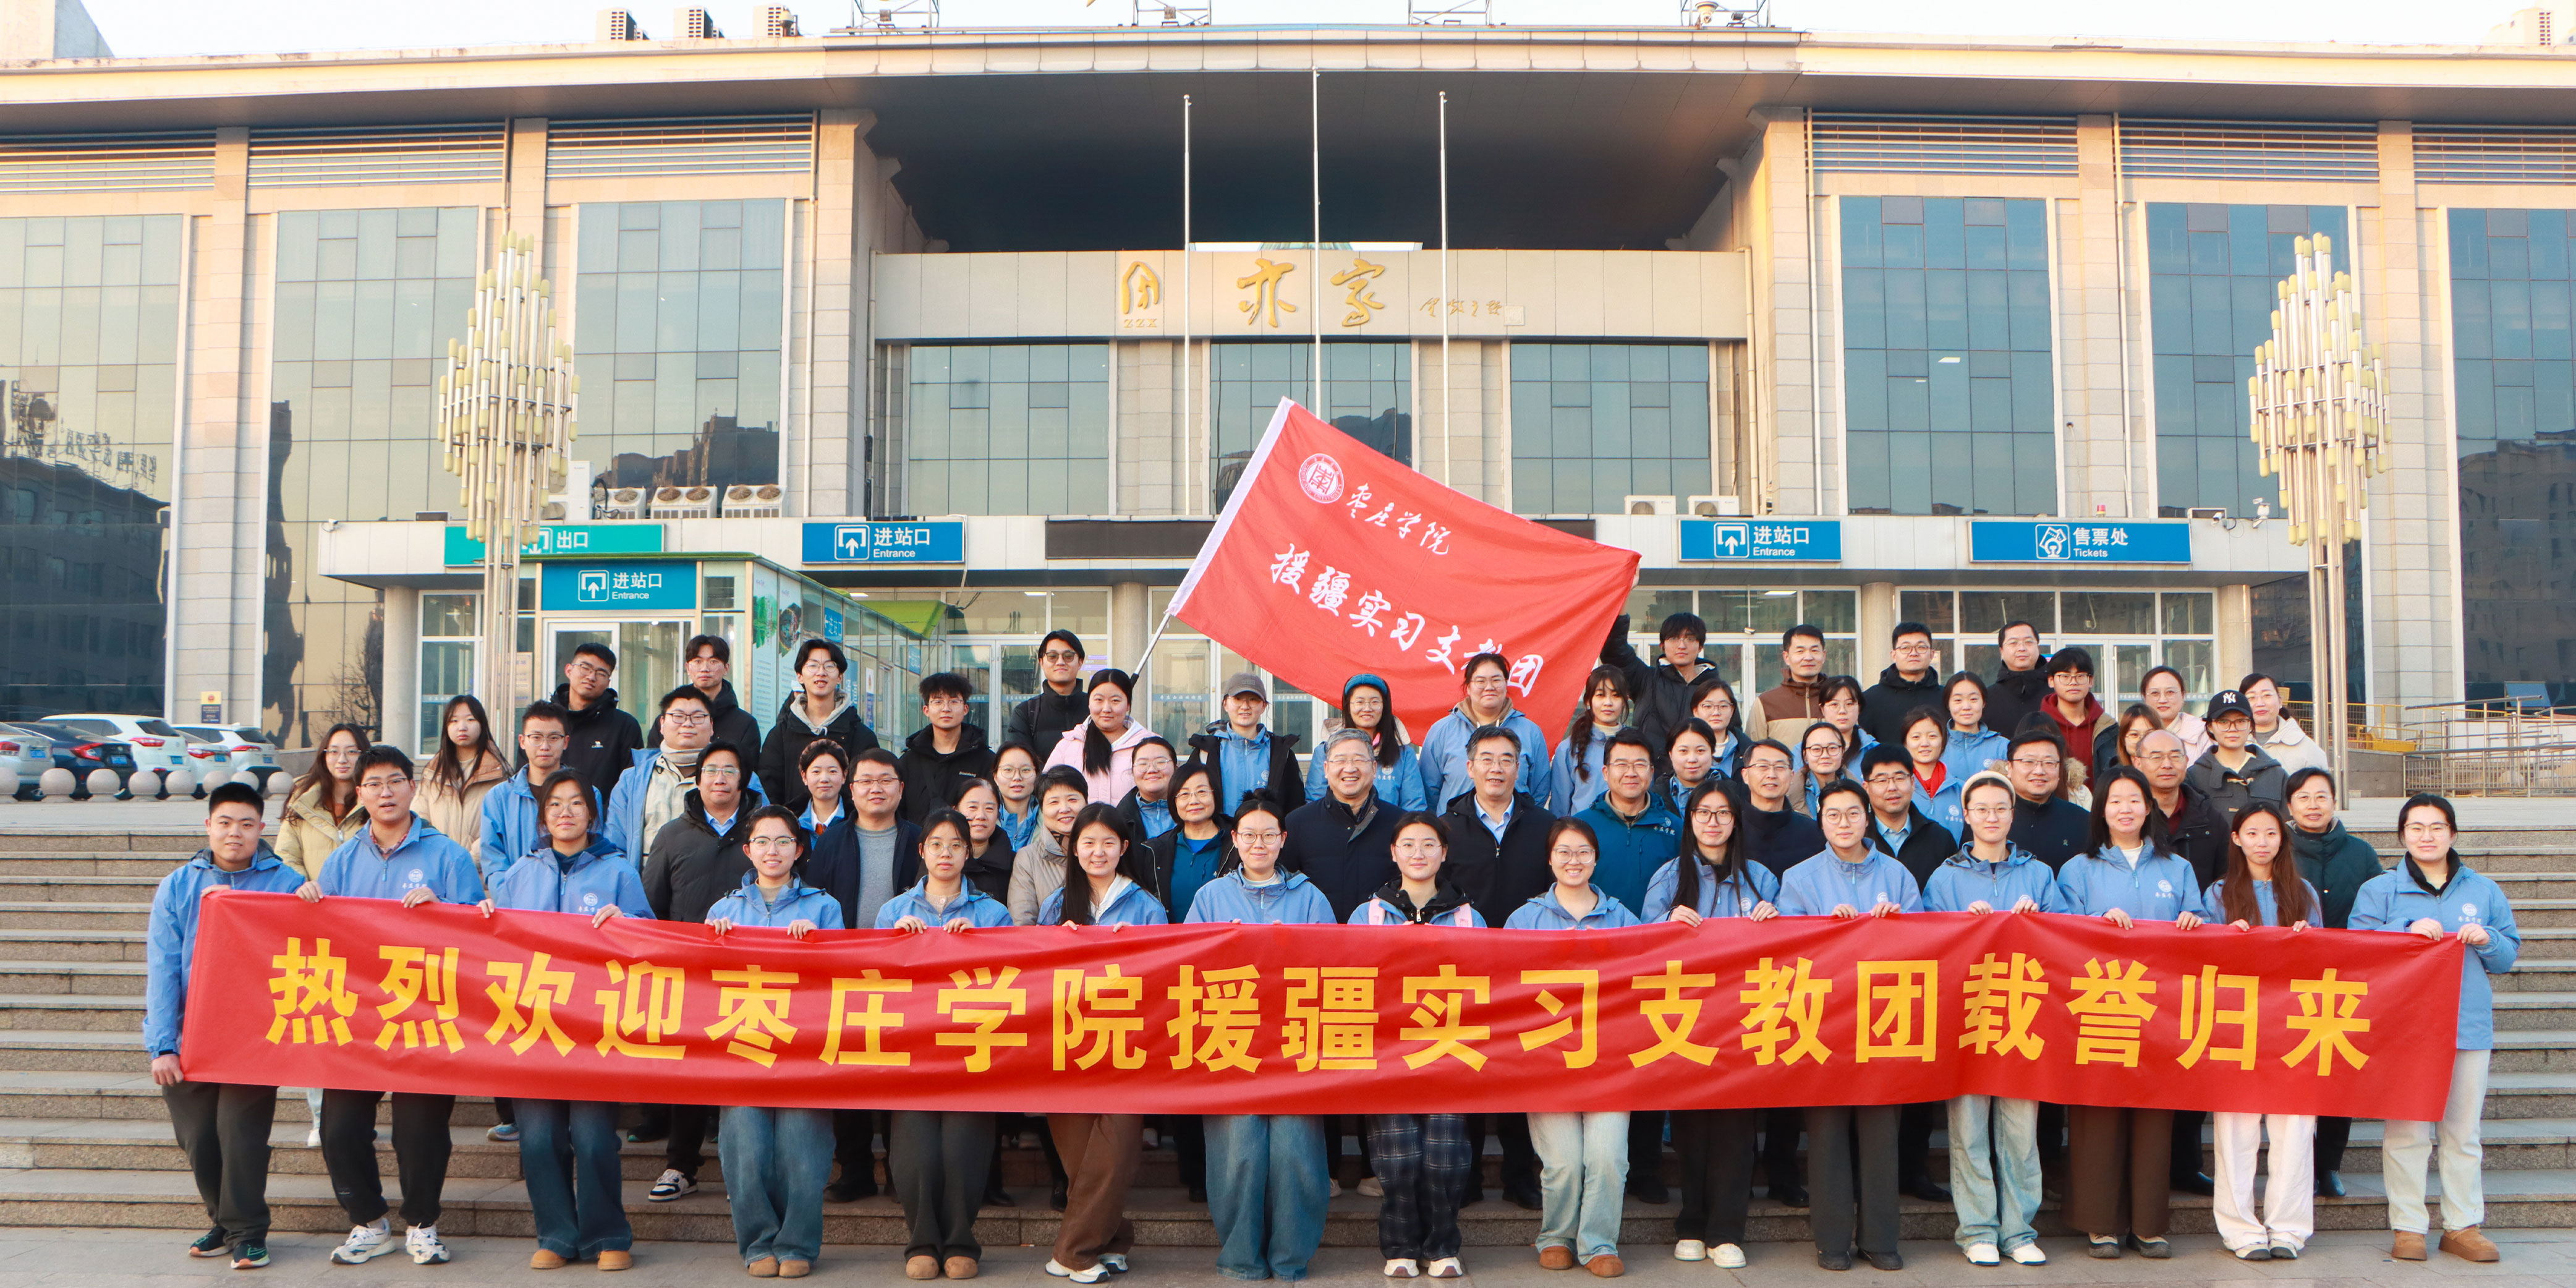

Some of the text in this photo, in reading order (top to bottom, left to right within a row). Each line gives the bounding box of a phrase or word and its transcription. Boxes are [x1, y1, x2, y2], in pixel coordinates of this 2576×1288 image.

[1124, 318, 1157, 328] ZZX
[1346, 482, 1452, 555] 枣庄学院
[556, 530, 589, 549] 出口
[874, 527, 930, 546] 进站口
[1753, 526, 1809, 544] 进站口
[2073, 527, 2129, 546] 售票处
[874, 548, 916, 558] Entrance
[1753, 547, 1796, 556] Entrance
[2073, 548, 2109, 557] Tickets
[613, 571, 662, 589] 进站口
[2223, 692, 2237, 704] NY
[265, 937, 2371, 1076] 热烈欢迎枣庄学院援疆实习支教团载誉归来
